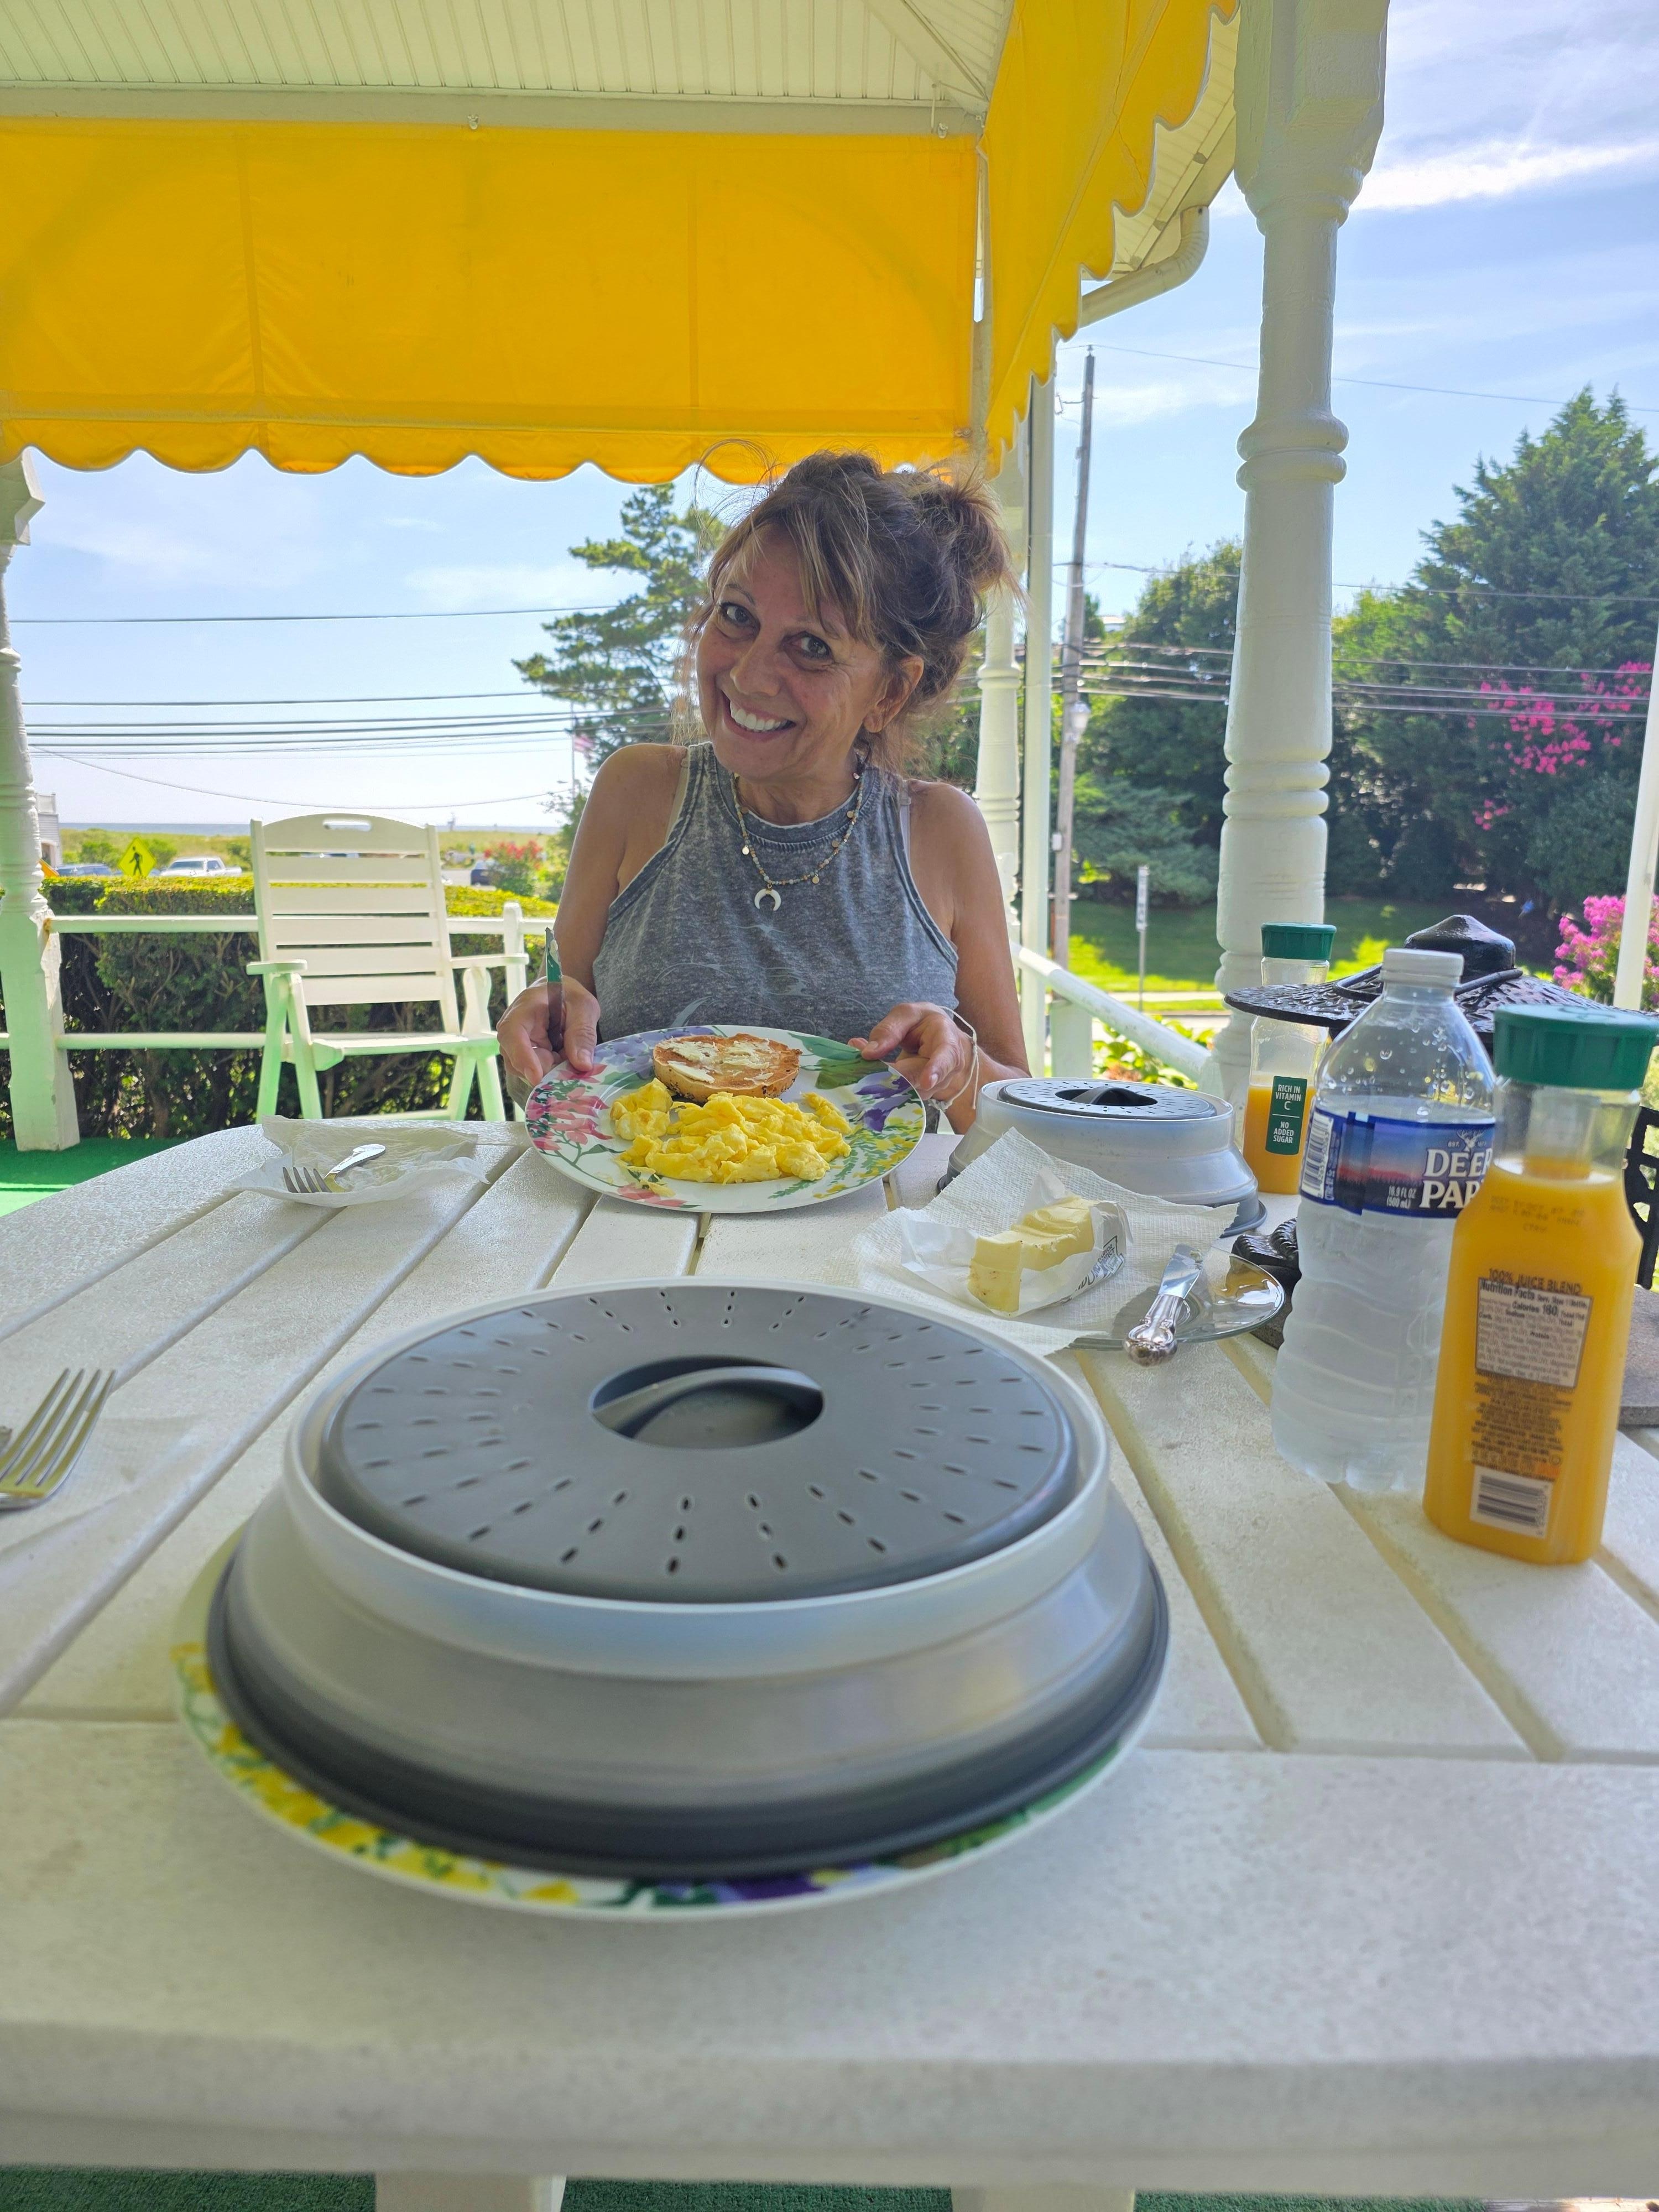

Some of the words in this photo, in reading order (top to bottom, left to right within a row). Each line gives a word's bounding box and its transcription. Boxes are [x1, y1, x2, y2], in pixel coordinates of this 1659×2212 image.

[1277, 1084, 1292, 1093] RICH
[1275, 1092, 1301, 1102] VITAMIN
[1284, 1101, 1291, 1110] C
[1273, 1128, 1294, 1136] ADDED
[1273, 1135, 1293, 1144] SUGAR
[1424, 1148, 1492, 1177] DEEP
[1418, 1179, 1484, 1209] PAR
[1489, 1268, 1514, 1285] 100%
[1516, 1274, 1544, 1291] JUICE
[1547, 1280, 1581, 1296] BLEND
[1480, 1279, 1512, 1296] Nutrition
[1515, 1286, 1535, 1300] Facts
[1512, 1300, 1540, 1313] Calories
